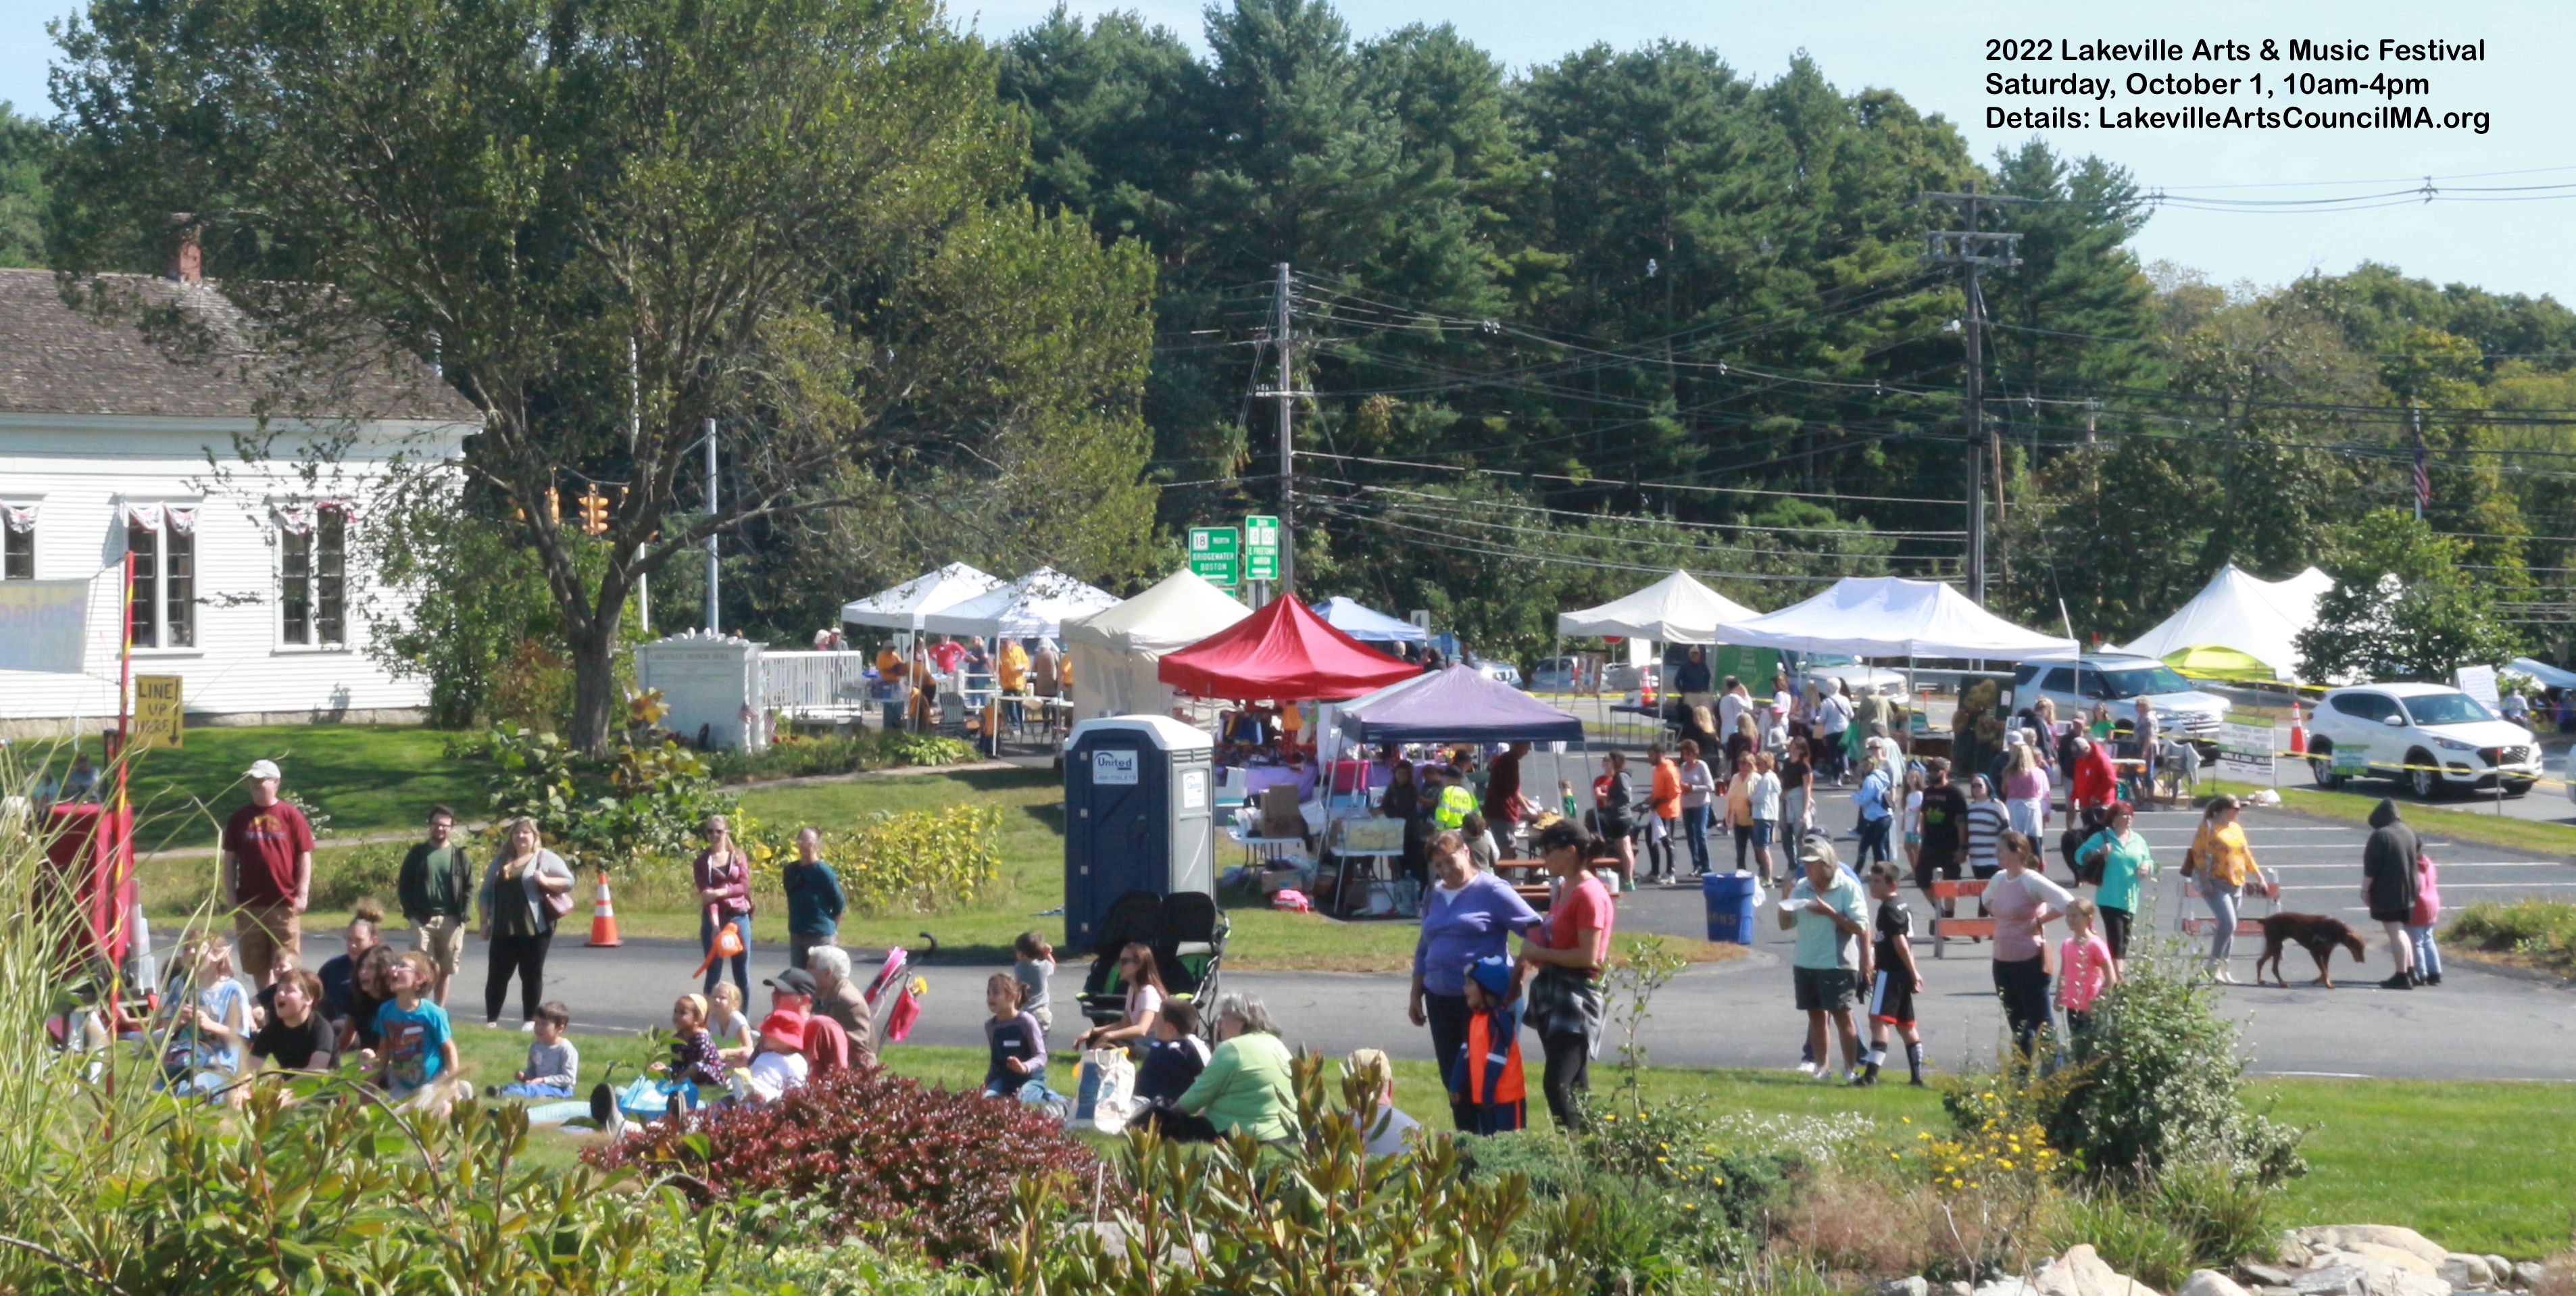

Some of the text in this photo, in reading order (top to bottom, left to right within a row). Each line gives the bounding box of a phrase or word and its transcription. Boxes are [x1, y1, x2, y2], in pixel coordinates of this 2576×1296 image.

[1195, 536, 1206, 547] 18
[1192, 552, 1235, 562] BRIDGEWATER
[1199, 563, 1227, 572] BOSTON
[138, 682, 174, 699] LINE
[148, 703, 168, 716] UP
[1098, 757, 1132, 767] United
